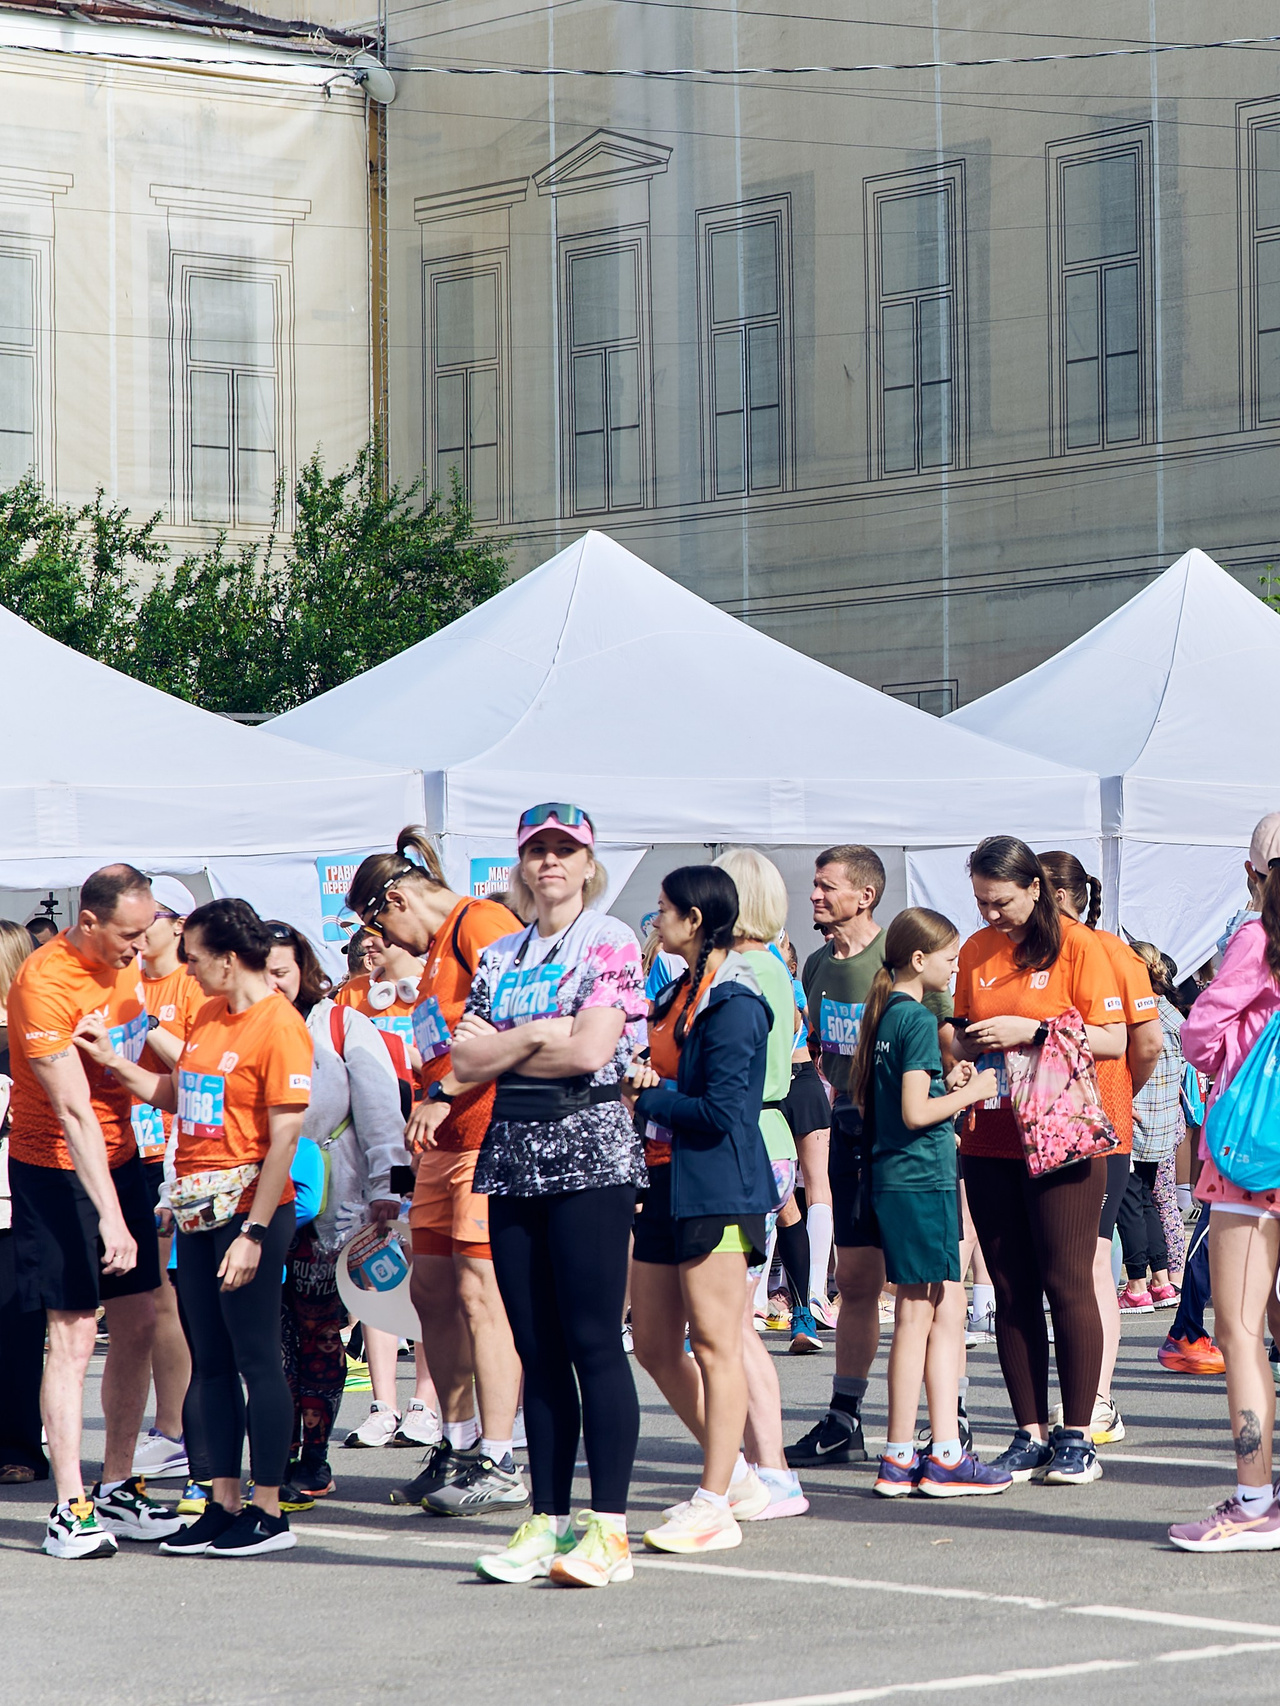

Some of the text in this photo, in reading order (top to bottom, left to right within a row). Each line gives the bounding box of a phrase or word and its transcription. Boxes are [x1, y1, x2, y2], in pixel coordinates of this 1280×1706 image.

[488, 866, 511, 881] МАС
[1030, 971, 1050, 990] 10
[498, 979, 551, 1020] 50278
[159, 1004, 176, 1022] 10
[217, 1051, 239, 1074] 10
